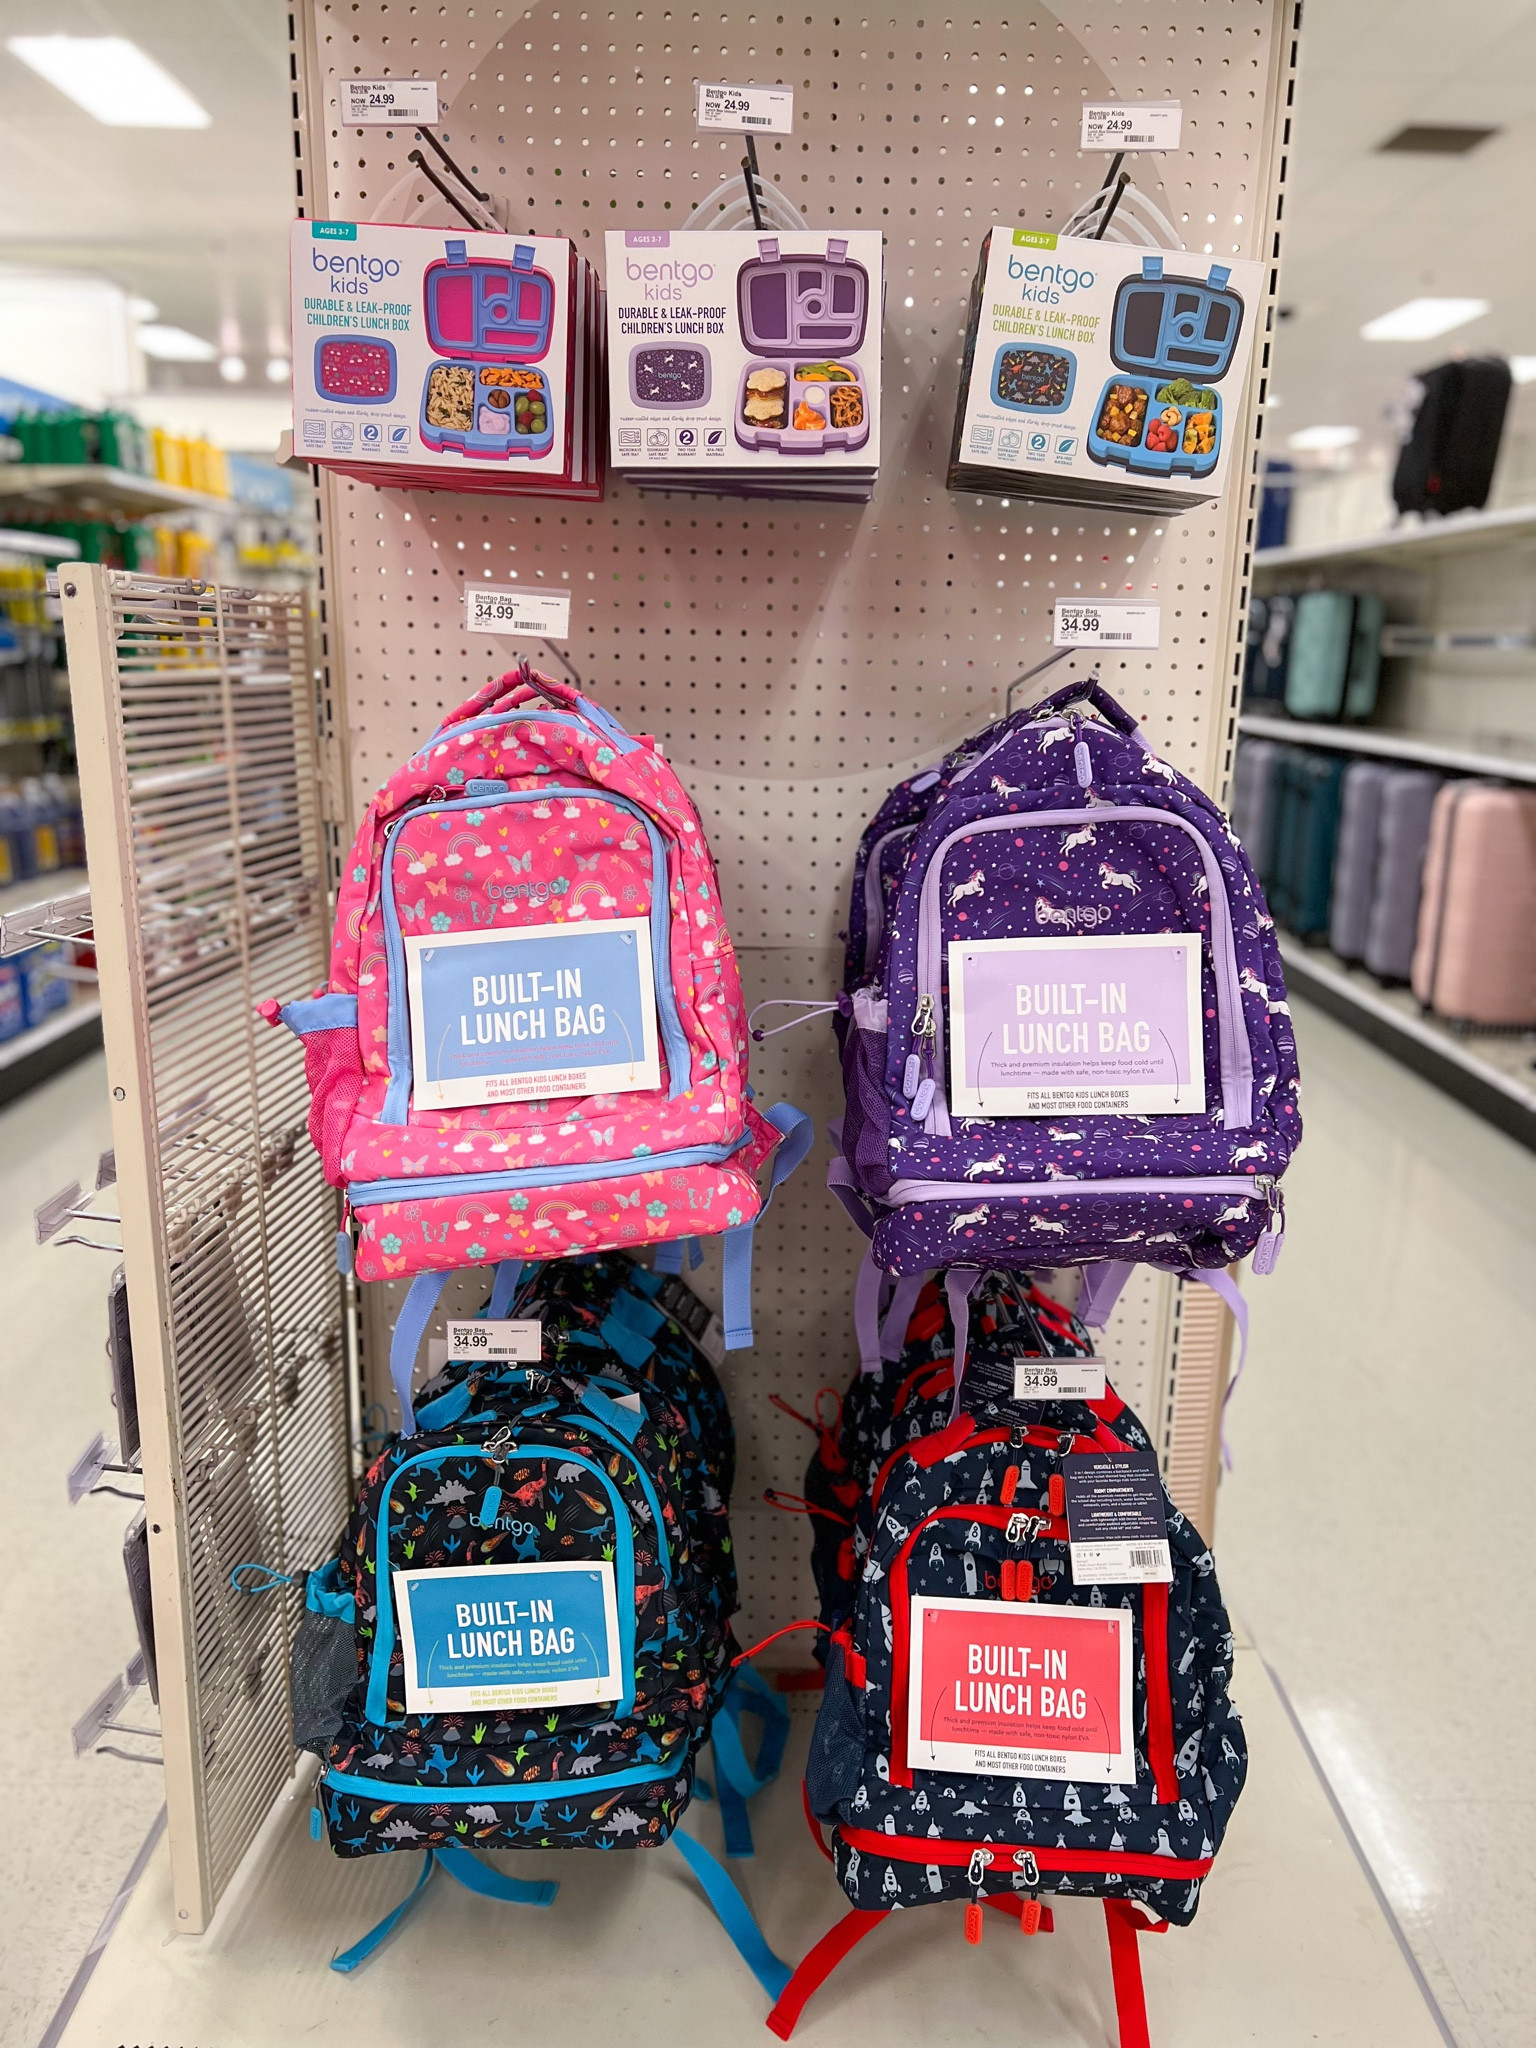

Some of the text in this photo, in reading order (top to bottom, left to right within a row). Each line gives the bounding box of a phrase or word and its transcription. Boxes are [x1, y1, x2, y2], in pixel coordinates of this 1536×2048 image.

[370, 94, 394, 104] 24.99
[724, 100, 750, 111] 24.99
[1107, 120, 1132, 130] 24.99
[1020, 235, 1037, 243] AGES
[313, 247, 400, 283] bentgo
[626, 257, 713, 288] bentgo
[1008, 254, 1094, 293] bentgo
[331, 275, 368, 294] kids
[644, 283, 682, 300] kids
[1022, 283, 1060, 304] kids
[304, 297, 412, 316] DURABLE & LEAK-PROOF
[618, 307, 726, 319] DURABLE & LEAK-PROOF
[307, 313, 410, 331] CHILDREN'S LUNCH BOX
[992, 304, 1100, 329] DURABLE & LEAK-PROOF
[621, 322, 724, 334] CHILDREN'S LUNCH BOX
[993, 319, 1095, 343] CHILDREN'S LUNCH BOX
[658, 372, 681, 380] bentgo
[1021, 373, 1045, 383] bentgo
[367, 427, 375, 439] 2
[683, 432, 690, 443] 2
[1034, 436, 1042, 448] 2
[476, 604, 514, 619] 34.99
[1061, 618, 1099, 631] 34.99
[472, 783, 505, 794] bentgo
[487, 881, 562, 902] bentgo
[1035, 905, 1111, 928] bentgo
[472, 968, 582, 1007] BUILT-IN
[1016, 983, 1126, 1016] BUILT-IN
[460, 1004, 606, 1046] LUNCH BAG
[1003, 1021, 1150, 1055] LUNCH BAG
[510, 1077, 532, 1086] BENTGO
[548, 1074, 567, 1082] LUNCH
[568, 1072, 587, 1080] BOXES
[500, 1088, 516, 1096] MOST
[517, 1086, 535, 1095] OTHER
[536, 1085, 550, 1093] FOOD
[552, 1082, 586, 1092] CONTAINERS
[454, 1336, 487, 1347] 34.99
[1024, 1376, 1057, 1386] 34.99
[469, 1513, 534, 1536] bntgo
[456, 1599, 554, 1628] BUILT-IN
[447, 1627, 575, 1659] LUNCH BAG
[968, 1644, 1067, 1681] BUILT-IN
[955, 1680, 1086, 1720] LUNCH BAG
[974, 1750, 986, 1758] FITS
[997, 1751, 1017, 1759] BENTGO
[1032, 1754, 1048, 1762] LUNCH
[1050, 1755, 1066, 1763] BOXES
[1002, 1762, 1018, 1770] OTHER
[1034, 1764, 1066, 1774] CONTAINERS
